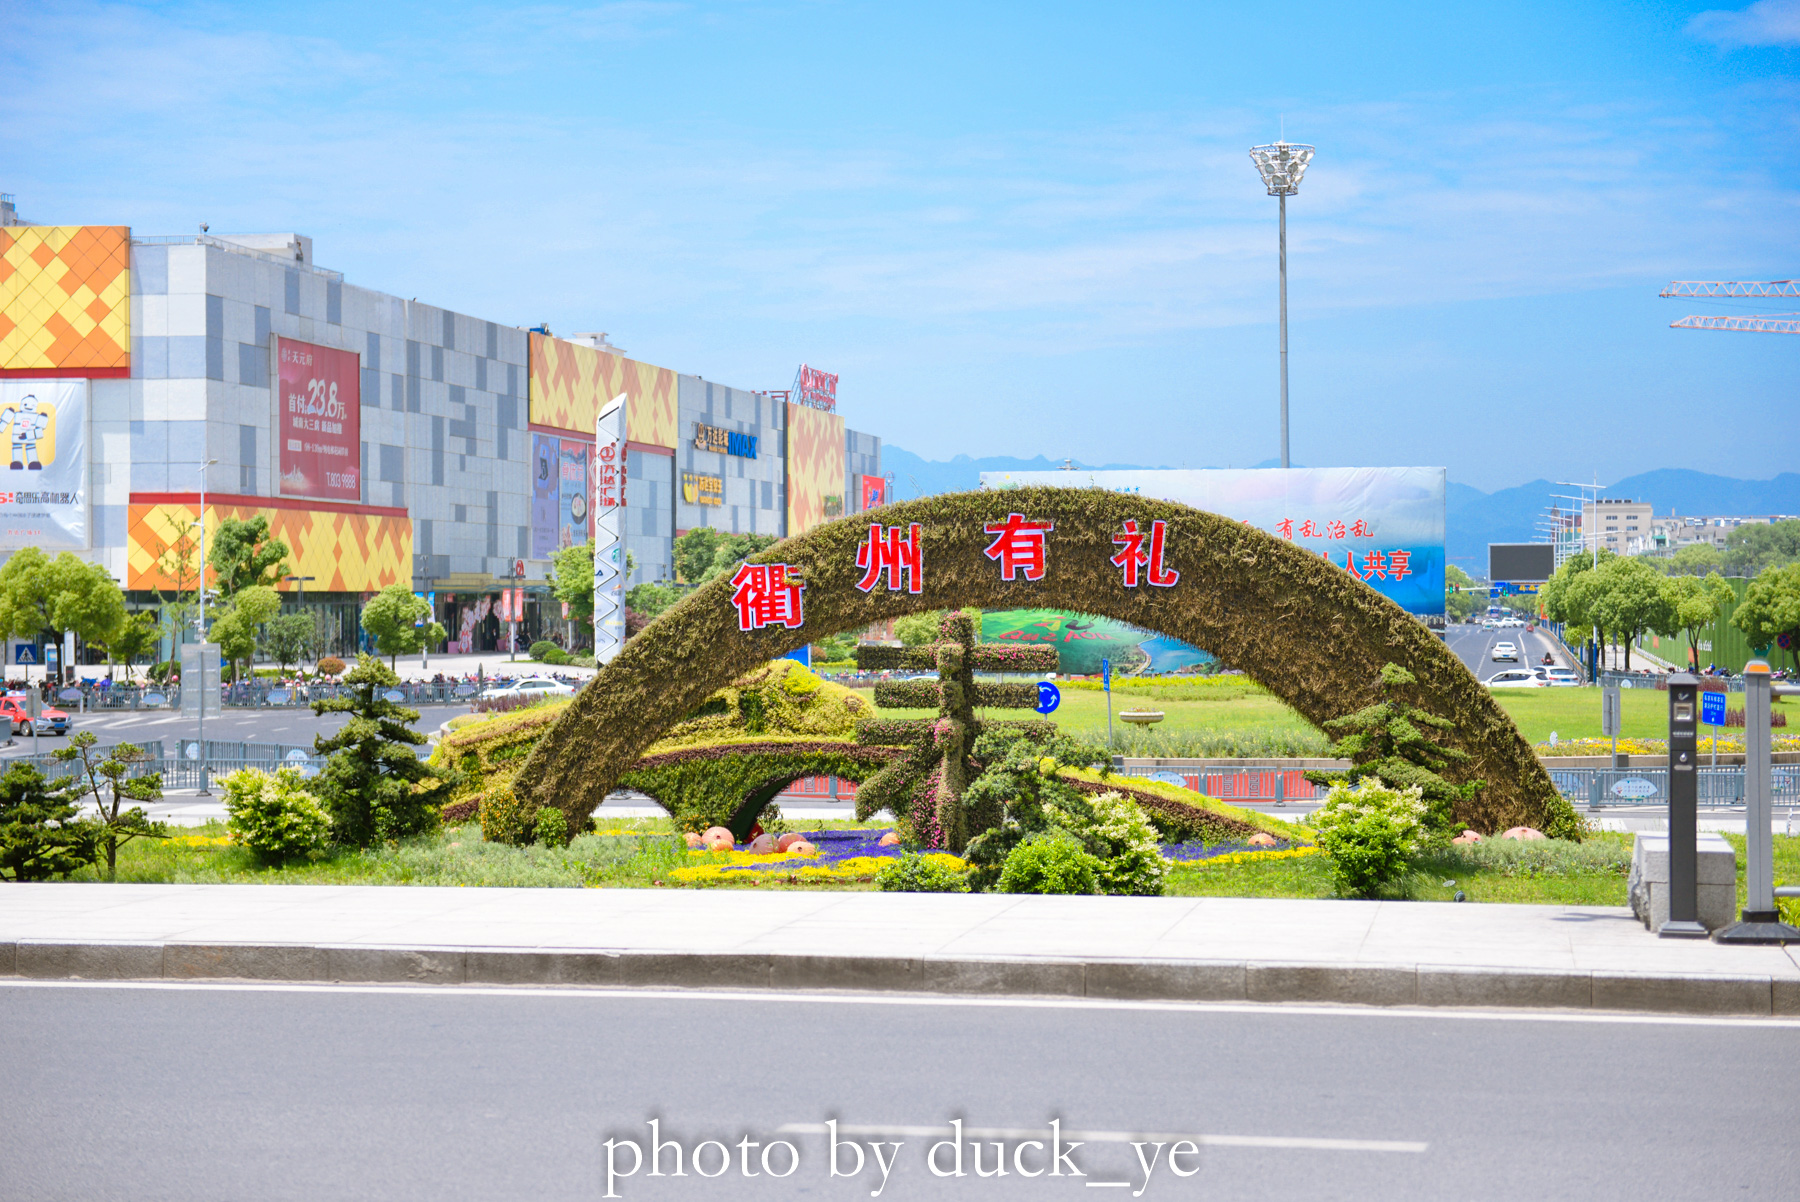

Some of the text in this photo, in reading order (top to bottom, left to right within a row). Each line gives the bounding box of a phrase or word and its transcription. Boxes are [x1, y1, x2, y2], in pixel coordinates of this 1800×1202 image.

[728, 431, 758, 460] IMAX
[1274, 517, 1375, 541] 有乱治乱
[730, 512, 1180, 632] 衢州有礼
[1322, 549, 1413, 582] 人共享
